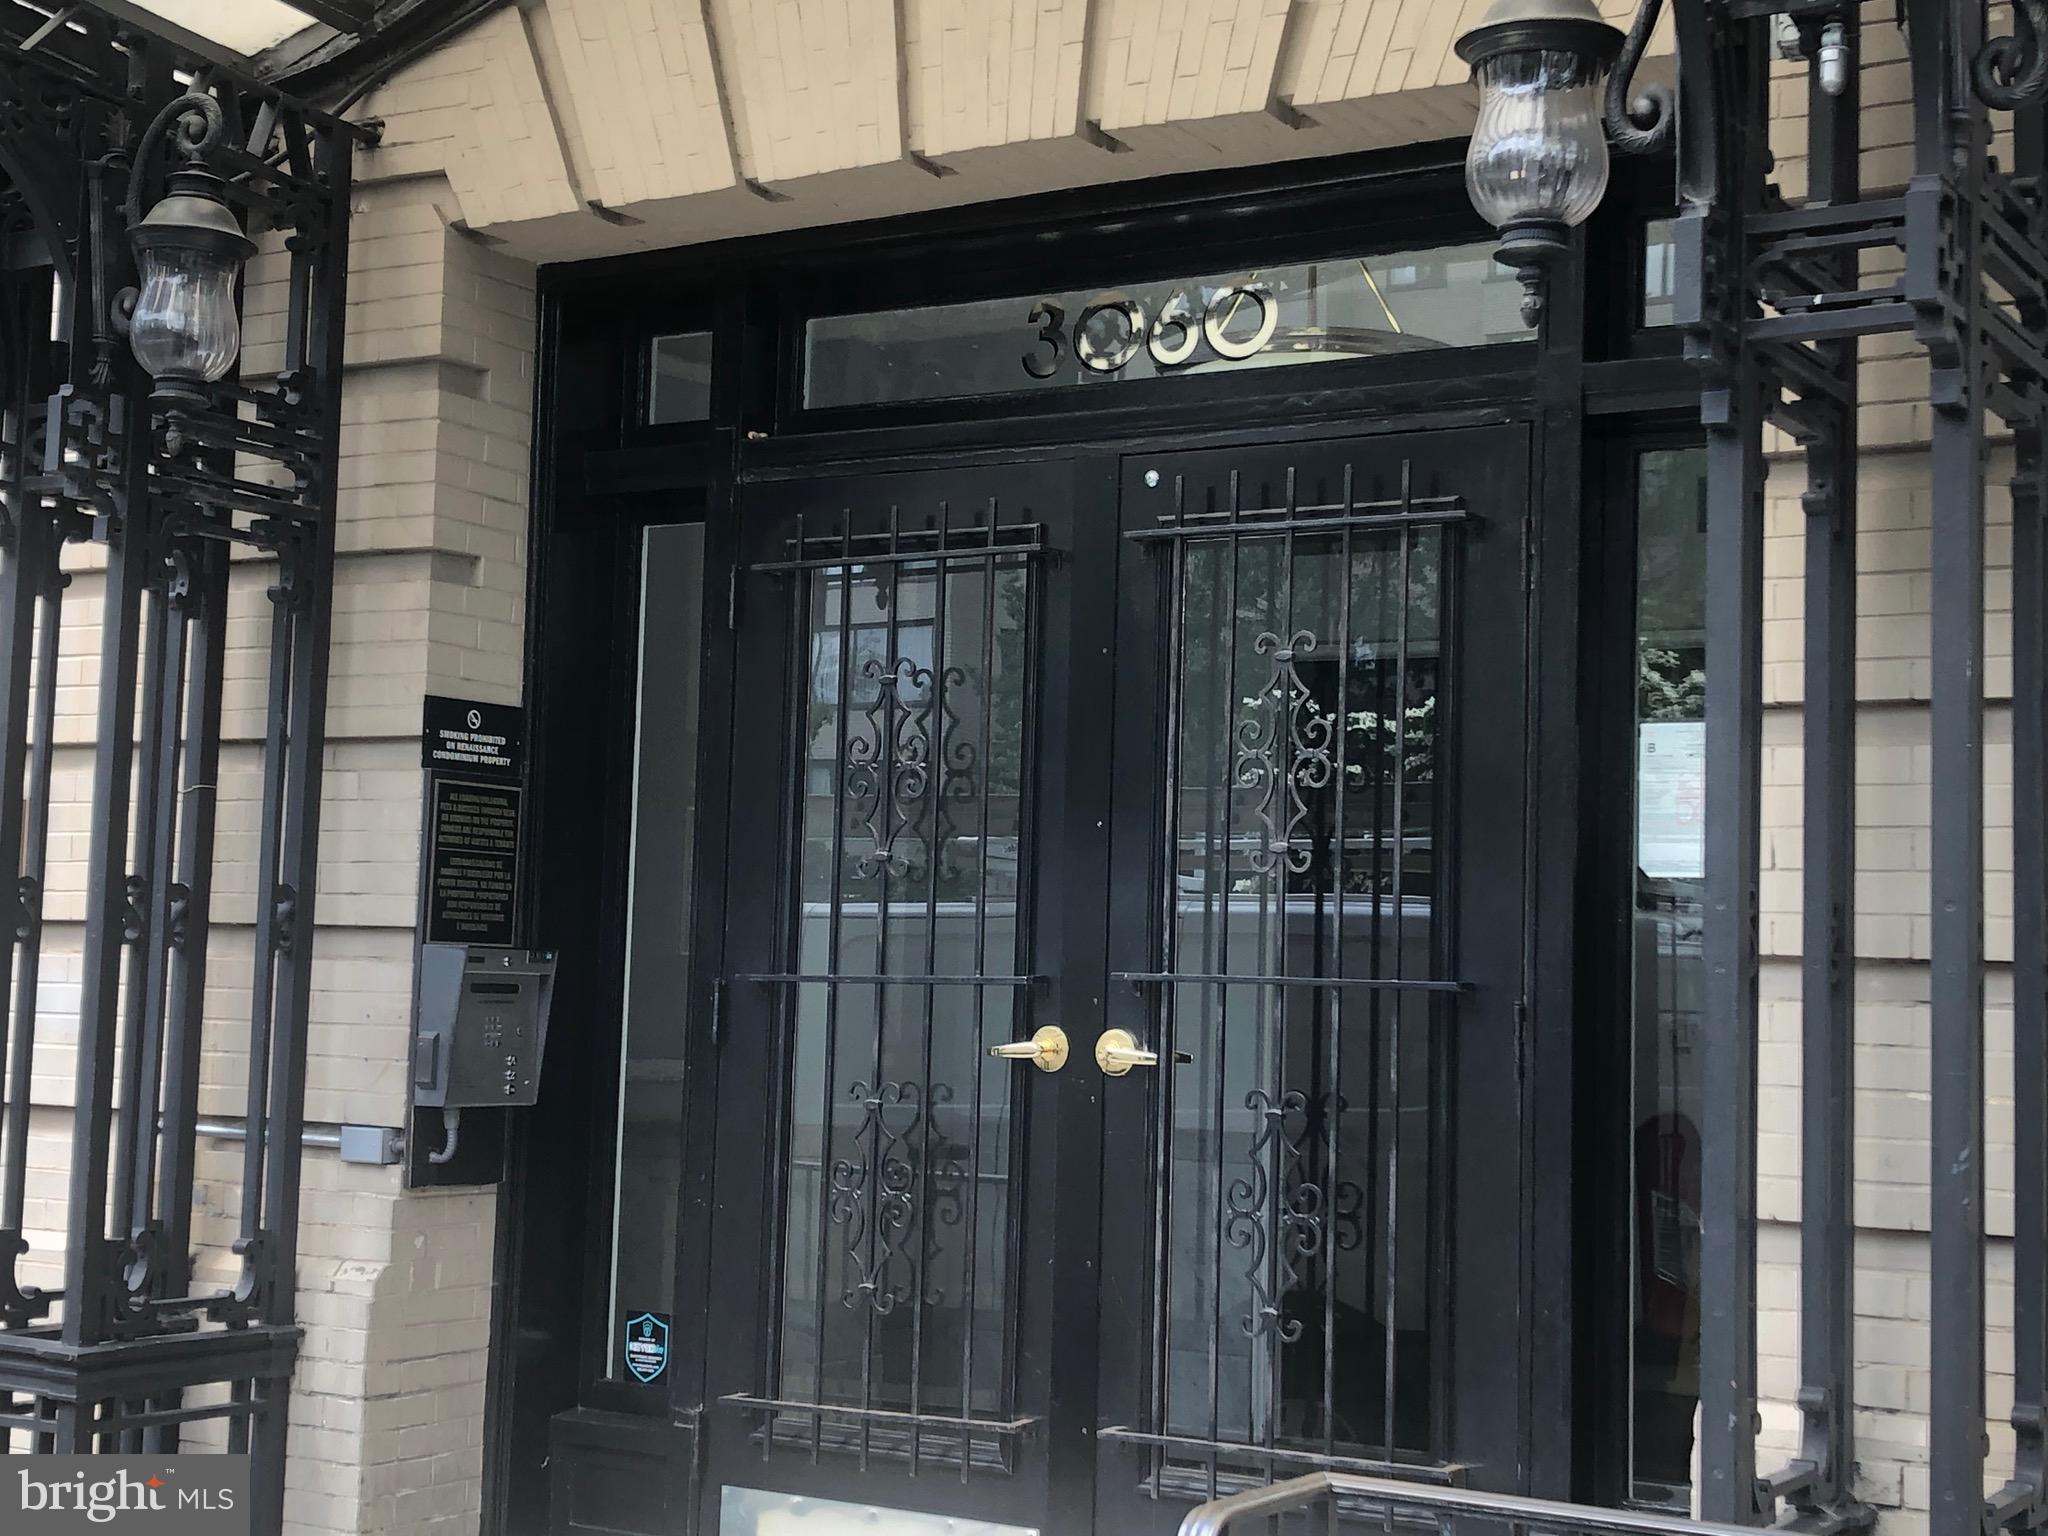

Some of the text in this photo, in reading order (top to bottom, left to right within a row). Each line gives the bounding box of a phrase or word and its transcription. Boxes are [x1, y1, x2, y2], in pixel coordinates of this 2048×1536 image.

[1021, 284, 1279, 379] 3060
[439, 729, 506, 746] SMOKING PROHIBITED
[446, 740, 499, 755] ON RENAISSANCE
[432, 749, 512, 767] CONDOMINIUM PROPERTY
